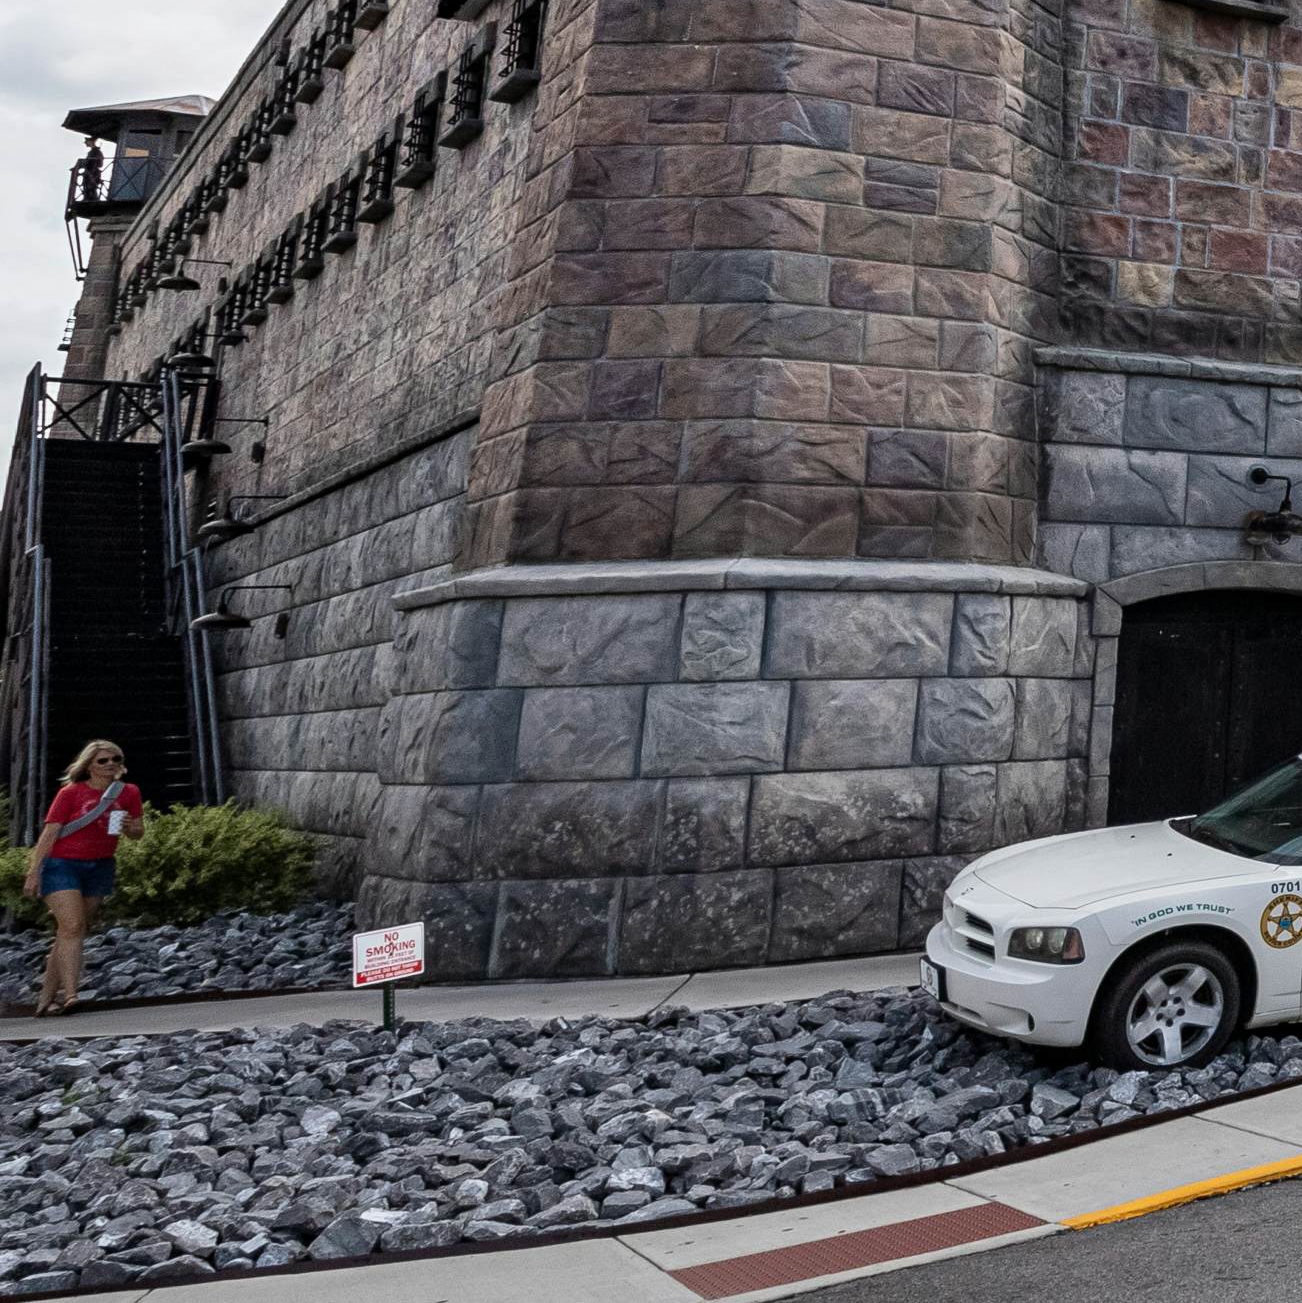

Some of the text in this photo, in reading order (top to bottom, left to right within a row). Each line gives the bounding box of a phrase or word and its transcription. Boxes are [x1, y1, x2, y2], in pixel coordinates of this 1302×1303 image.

[1271, 881, 1300, 894] 0701
[1149, 907, 1174, 921] GOD
[1176, 904, 1194, 912] WE
[384, 931, 399, 942] NO
[366, 939, 416, 957] SMOKING
